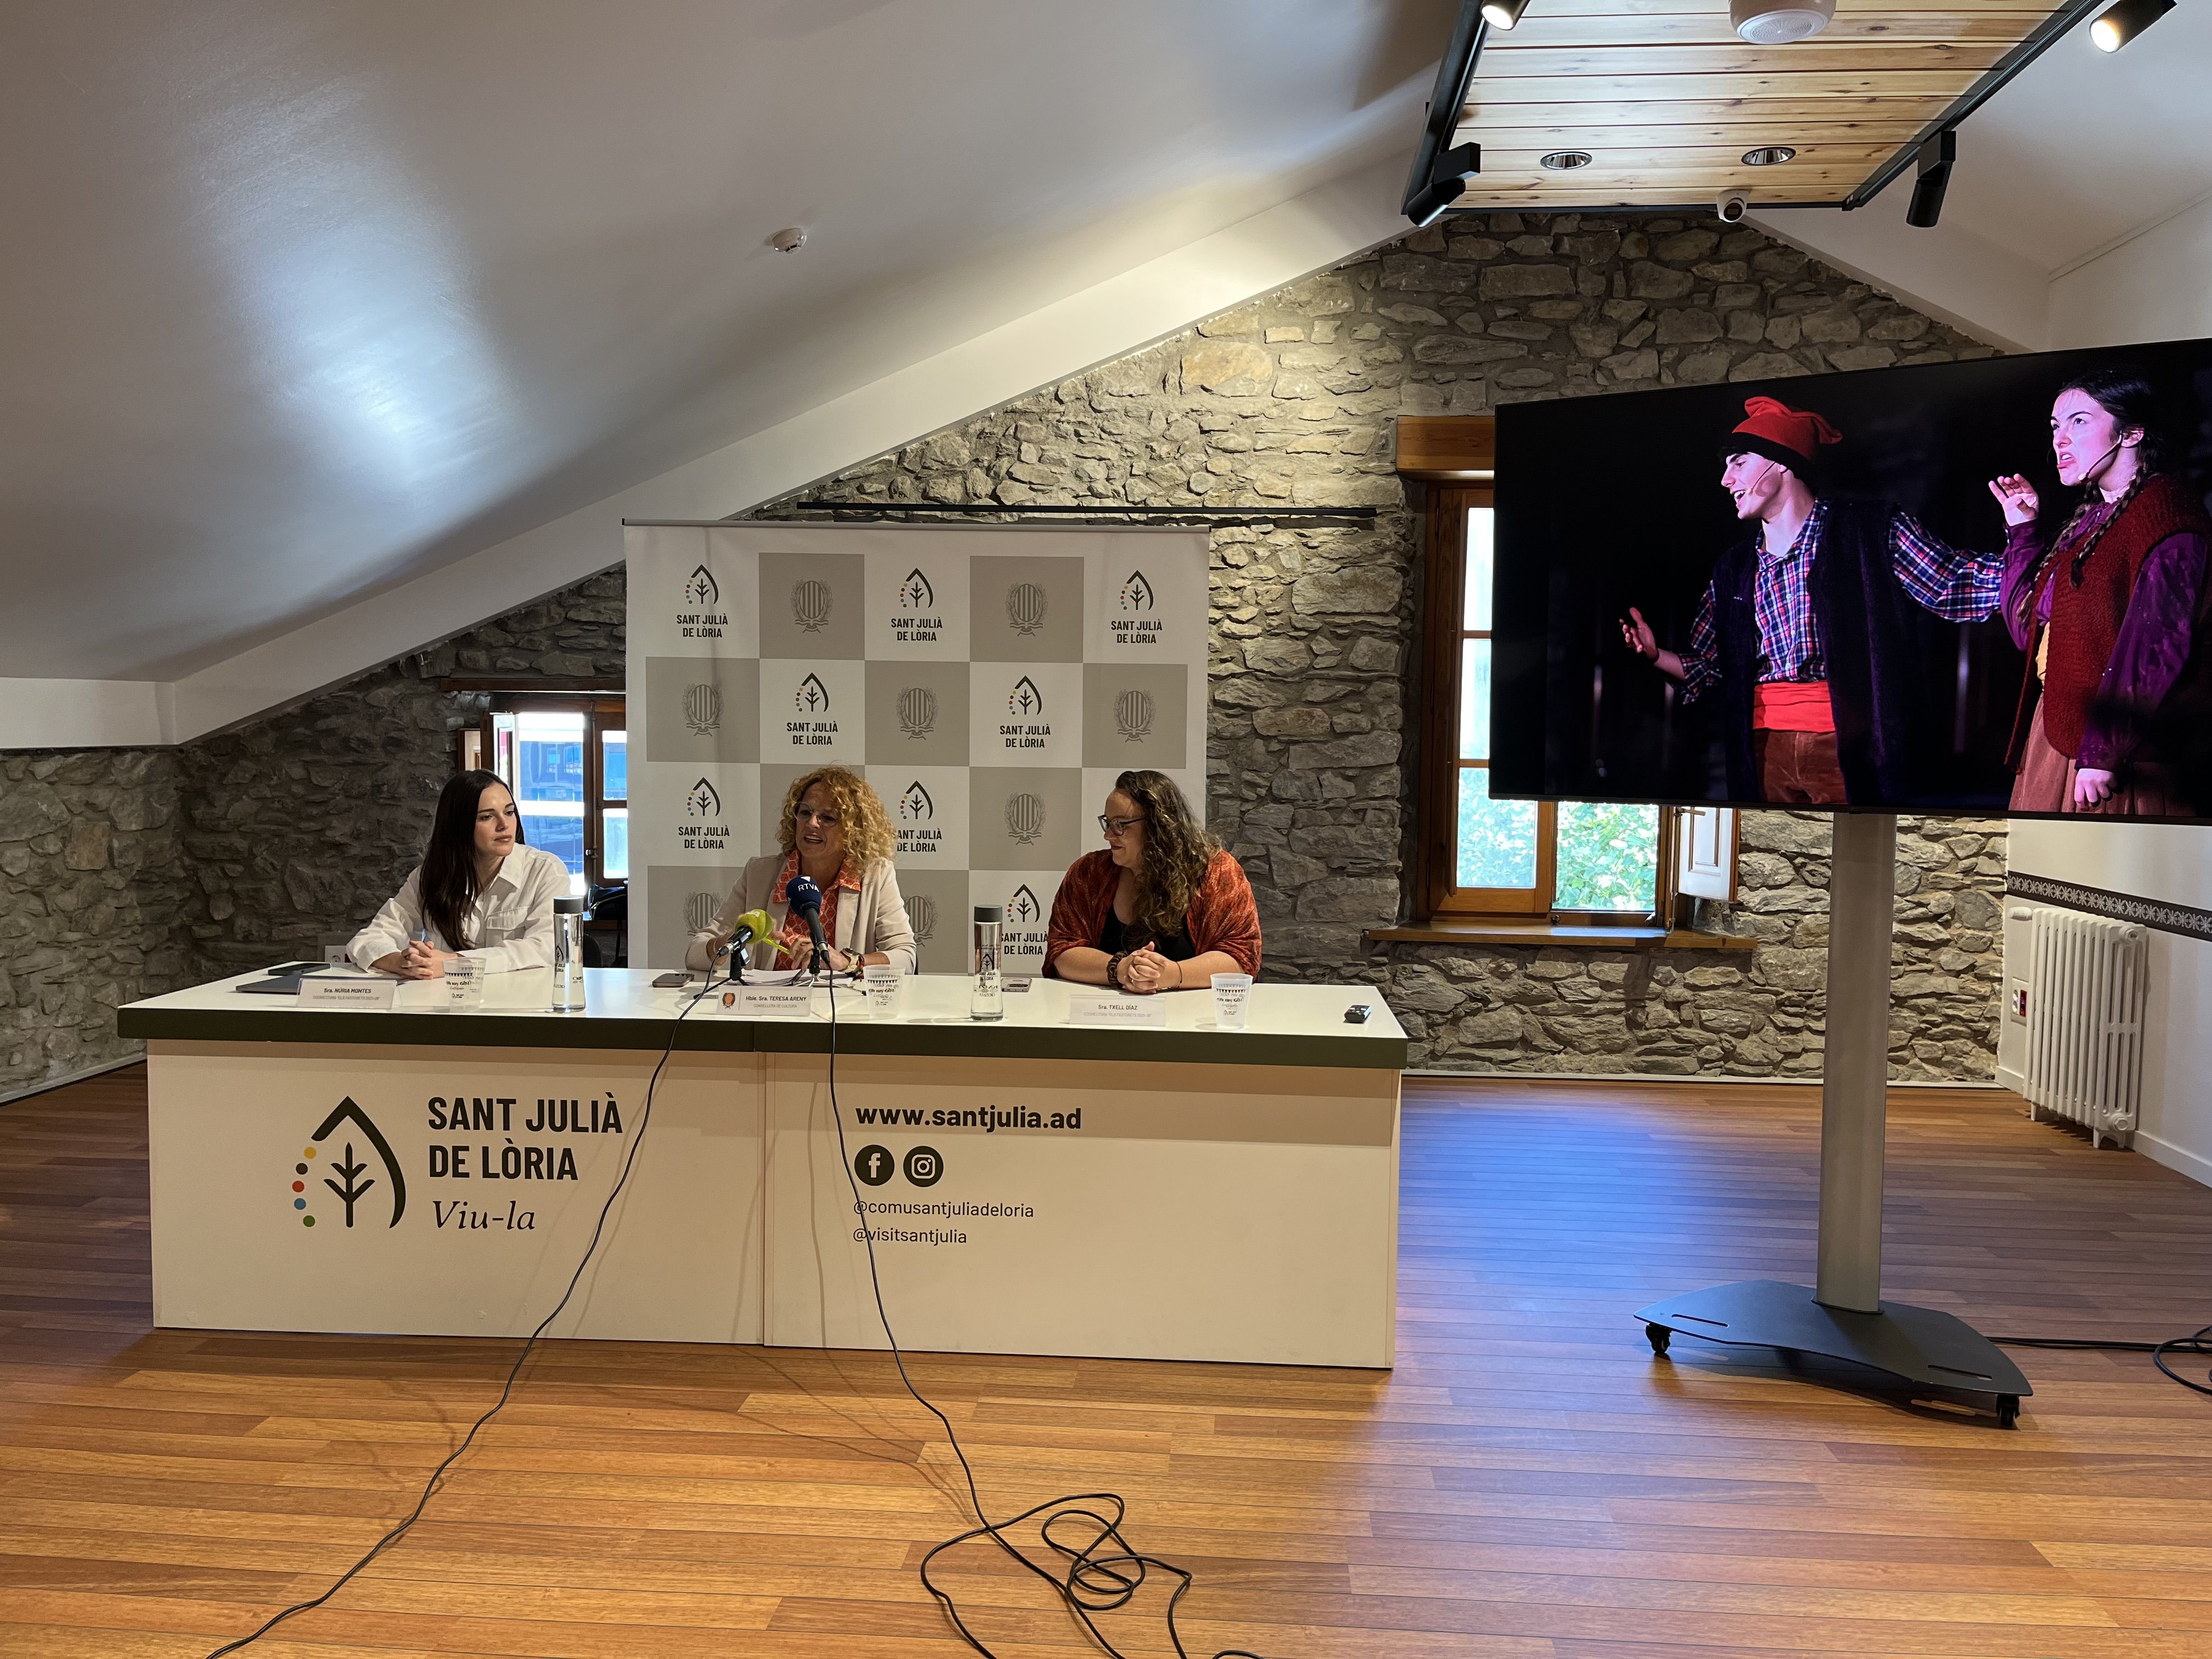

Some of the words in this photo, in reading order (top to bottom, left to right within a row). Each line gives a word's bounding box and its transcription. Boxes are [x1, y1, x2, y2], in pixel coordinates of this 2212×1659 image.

[676, 614, 700, 624] SANT
[702, 613, 728, 625] JULIÀ
[891, 618, 915, 628] SANT
[916, 616, 943, 629] JULIÀ
[1111, 620, 1135, 631] SANT
[1136, 618, 1163, 631] JULIÀ
[682, 628, 694, 637] DE
[697, 625, 723, 638] LÒRIA
[897, 631, 909, 641] DE
[911, 629, 936, 641] LÒRIA
[1116, 634, 1128, 644] DE
[1130, 631, 1156, 644] LÒRIA
[786, 722, 810, 732] SANT
[812, 720, 838, 733] JULIÀ
[1000, 725, 1024, 735] SANT
[1025, 723, 1051, 736] JULIÀ
[792, 735, 804, 745] DE
[806, 733, 832, 746] LÒRIA
[1006, 738, 1017, 748] DE
[1019, 736, 1045, 748] LÒRIA
[678, 826, 702, 836] SANT
[703, 825, 730, 837] JULIÀ
[898, 830, 915, 839] ANT
[916, 828, 942, 840] JULIÀ
[684, 839, 696, 849] DE
[698, 837, 724, 849] LÒRIA
[897, 842, 909, 852] DE
[911, 840, 936, 853] LÒRIA
[798, 883, 820, 893] RTVA
[1023, 930, 1048, 943] JULIÀ
[1004, 945, 1015, 955] DE
[1018, 943, 1043, 955] LÒRIA
[428, 1097, 517, 1131] SANT
[526, 1092, 623, 1133] JULIÀ
[855, 1104, 1081, 1133] www.santjulia.ad
[429, 1145, 470, 1178] DE
[482, 1137, 578, 1181] LÒRIA
[432, 1200, 535, 1230] Viu-la
[854, 1200, 1034, 1219] @comusantjuliadeloria
[853, 1227, 967, 1246] @visitsantjulia
